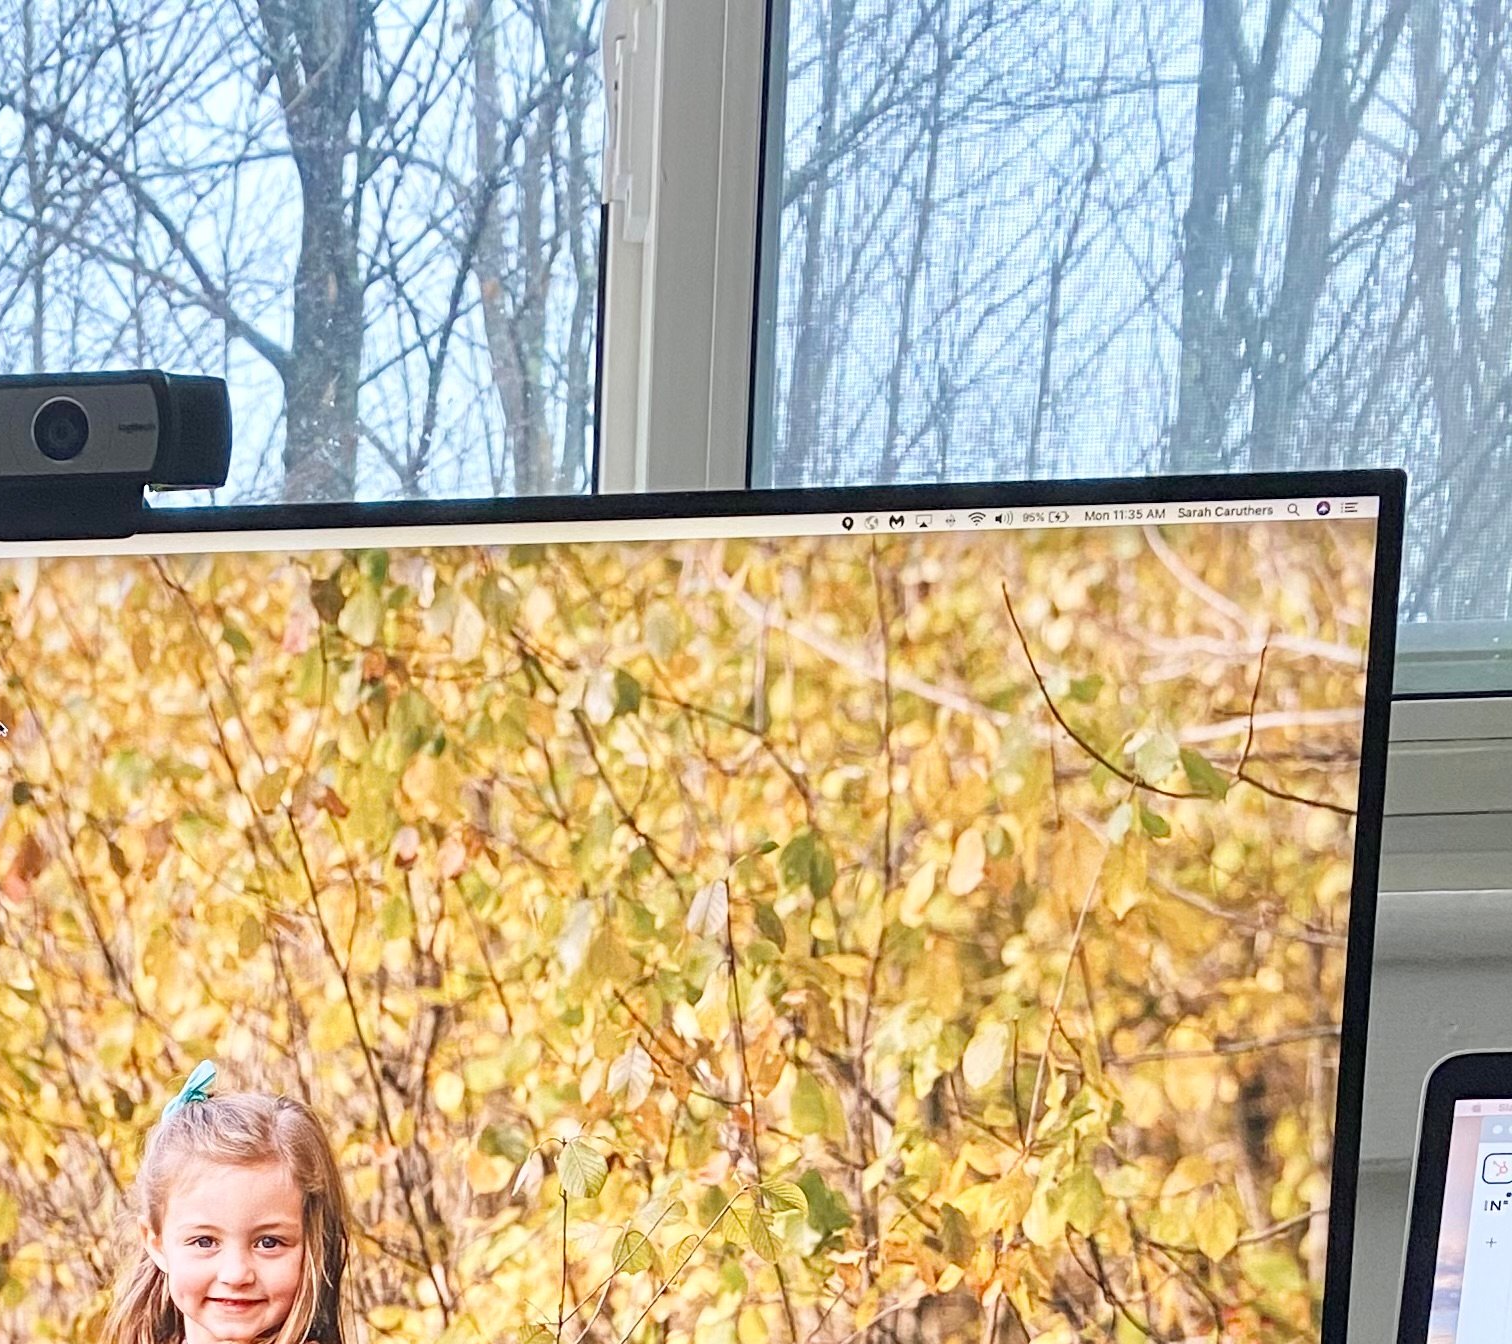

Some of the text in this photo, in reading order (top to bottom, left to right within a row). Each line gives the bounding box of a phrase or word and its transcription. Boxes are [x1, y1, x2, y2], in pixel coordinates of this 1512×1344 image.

[1085, 511, 1110, 521] Mon
[1113, 509, 1143, 520] 11:35
[1146, 508, 1166, 519] AM
[1178, 507, 1212, 518] Sarah
[1215, 505, 1274, 517] Caruthers
